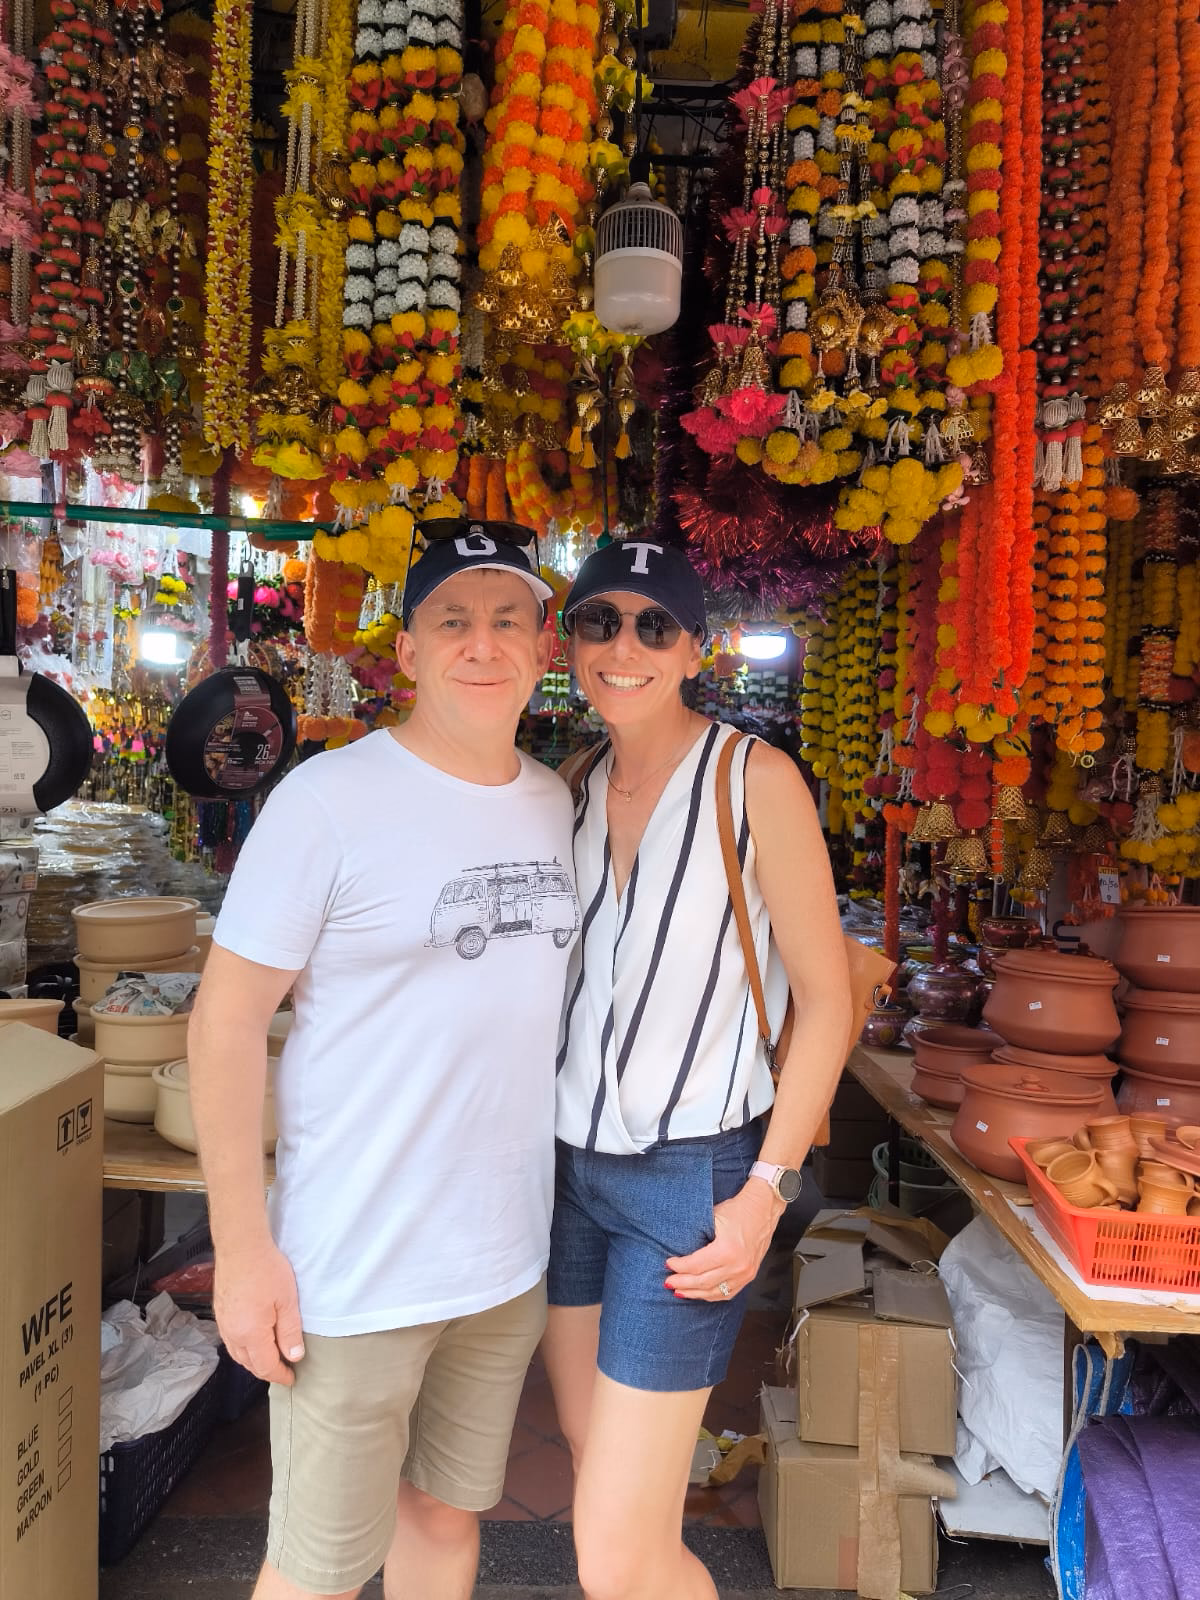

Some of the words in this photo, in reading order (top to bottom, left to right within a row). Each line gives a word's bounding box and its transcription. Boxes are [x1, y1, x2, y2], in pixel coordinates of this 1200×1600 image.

[621, 542, 664, 575] T
[255, 744, 271, 760] 26
[21, 1281, 73, 1356] WFE
[19, 1351, 46, 1388] PAVEL
[47, 1339, 60, 1360] XL
[34, 1380, 42, 1403] (1
[44, 1363, 59, 1389] PC)
[17, 1424, 39, 1461] BLUE
[17, 1450, 40, 1487] GOLD
[16, 1469, 45, 1513] GREEN
[16, 1486, 53, 1543] MAROON
